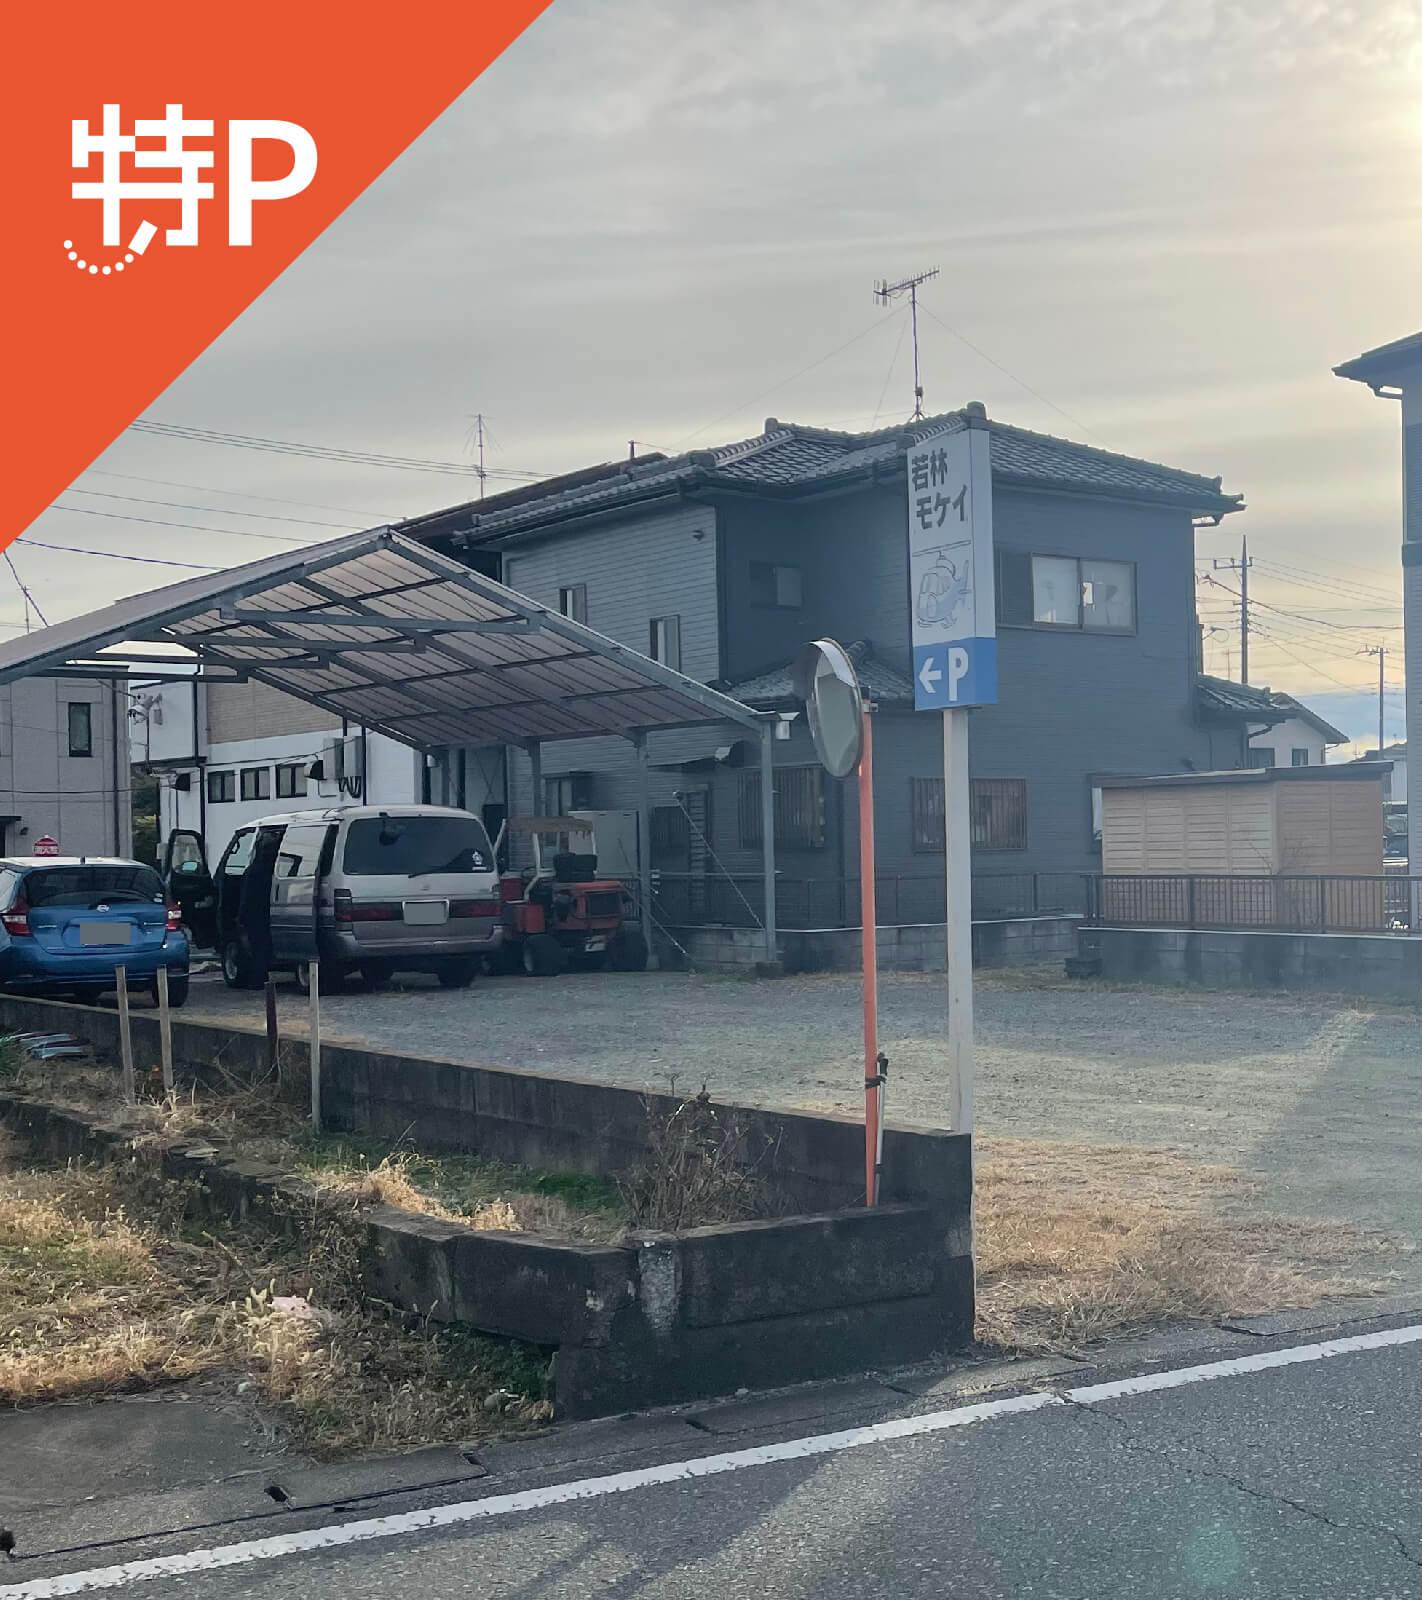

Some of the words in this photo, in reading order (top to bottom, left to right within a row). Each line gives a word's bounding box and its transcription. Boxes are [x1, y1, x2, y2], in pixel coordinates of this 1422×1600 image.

[911, 448, 948, 491] 若林
[916, 484, 968, 530] モケイ
[948, 647, 969, 701] P
